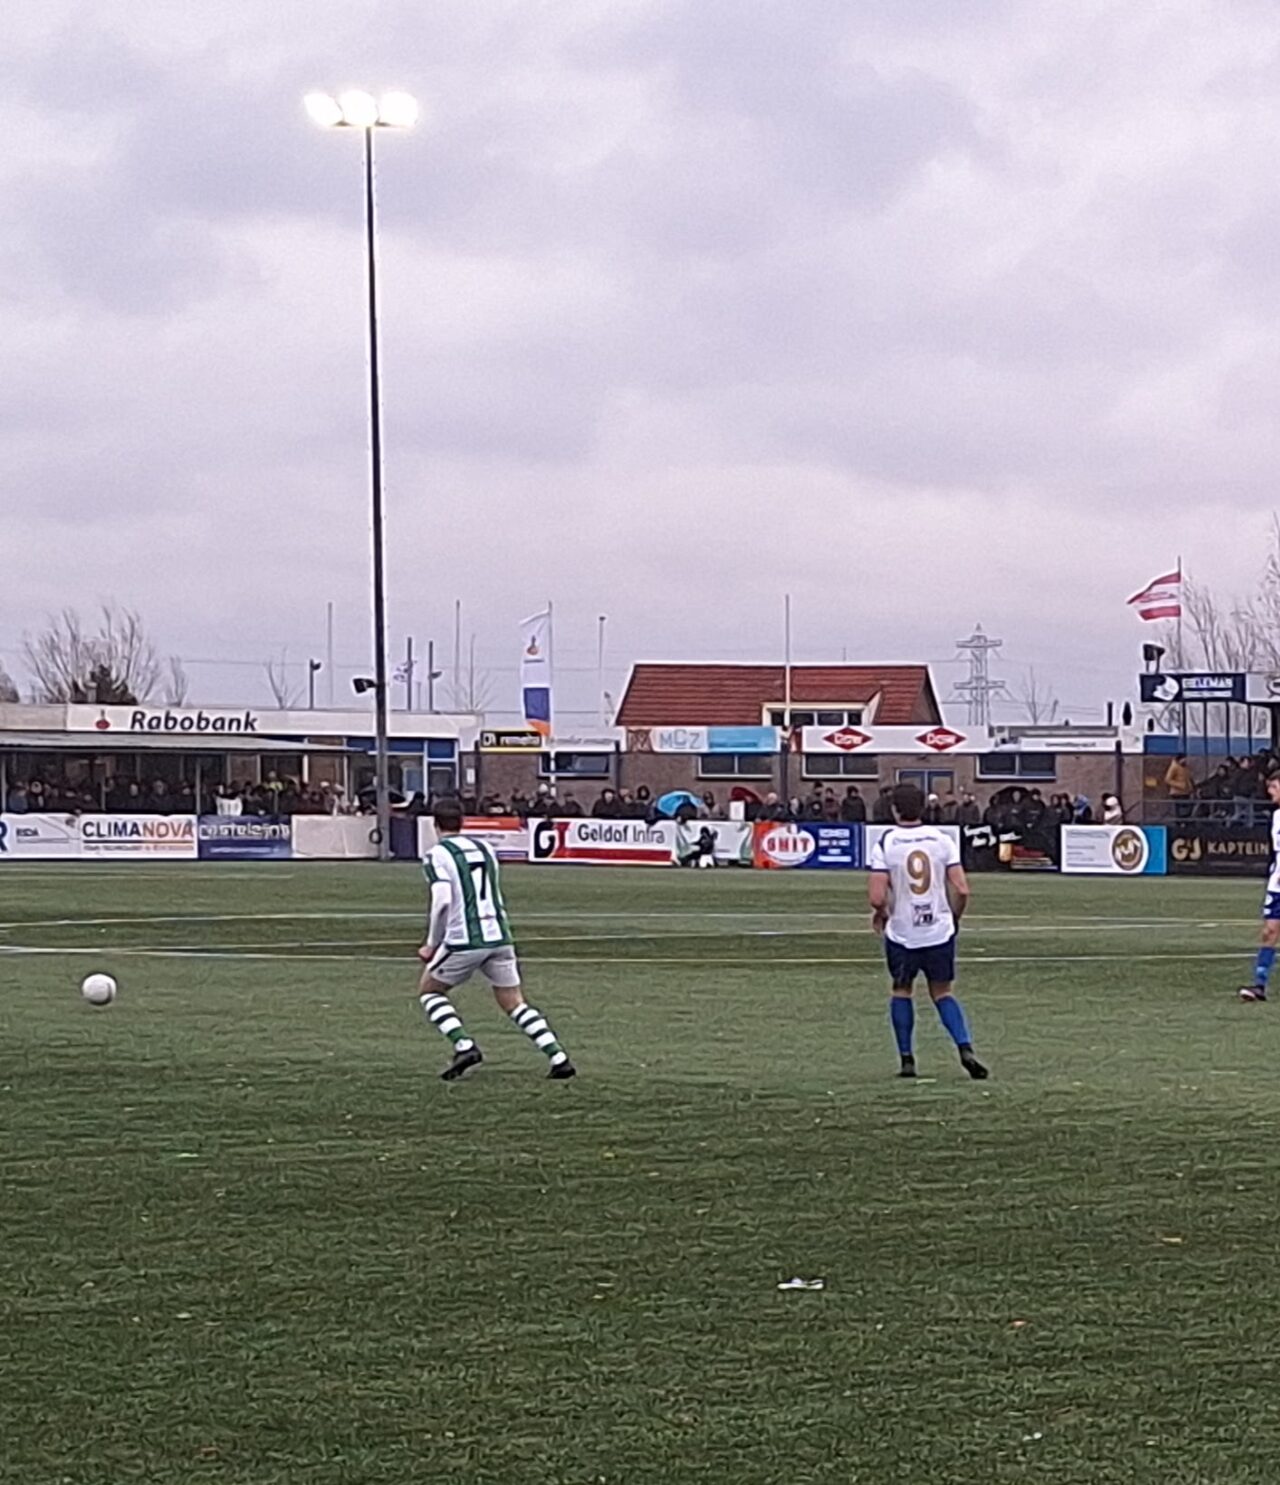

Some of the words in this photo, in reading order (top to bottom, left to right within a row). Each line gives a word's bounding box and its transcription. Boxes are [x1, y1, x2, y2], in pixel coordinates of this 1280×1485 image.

[130, 710, 258, 732] Rabobank
[82, 821, 194, 838] CLIMANOVA
[578, 823, 628, 842] Geldof
[633, 826, 666, 844] Infra
[907, 850, 931, 895] 9
